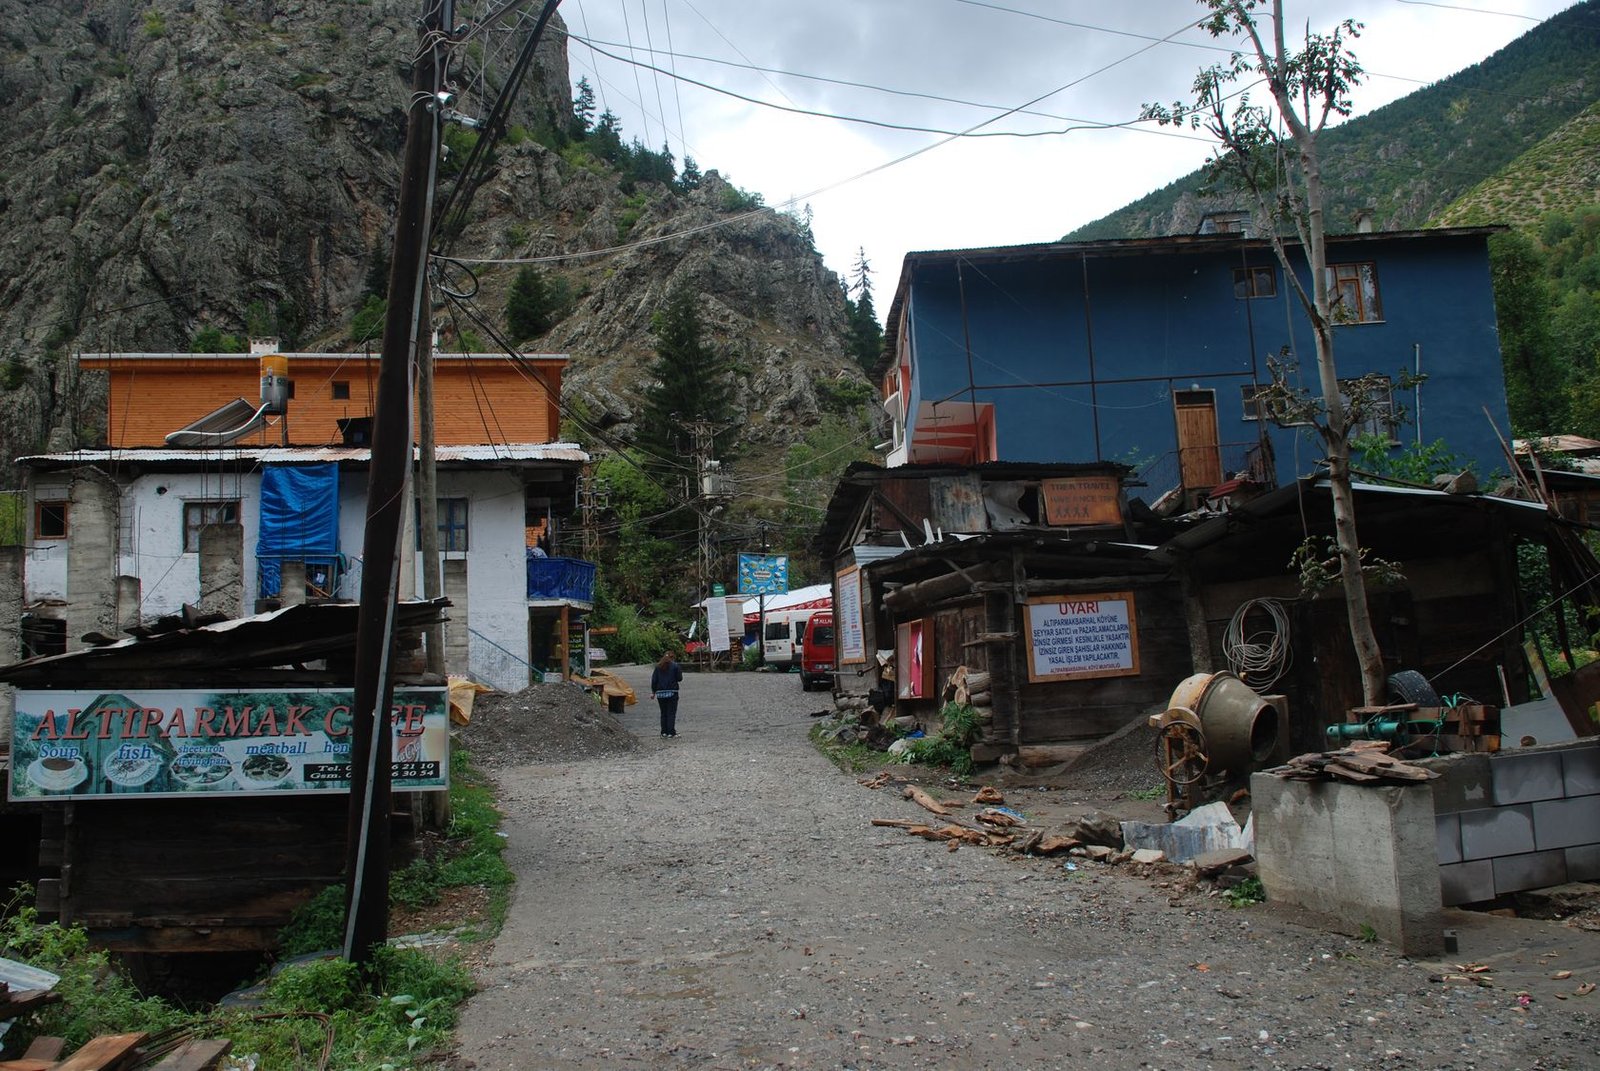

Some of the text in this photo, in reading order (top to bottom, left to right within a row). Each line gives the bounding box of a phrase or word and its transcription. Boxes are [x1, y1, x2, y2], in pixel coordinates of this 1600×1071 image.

[1059, 601, 1100, 615] UYARI
[1033, 628, 1054, 637] SEYYAR
[1055, 627, 1072, 636] SATICI
[31, 703, 428, 741] ALTIPARMAK CE
[39, 742, 79, 759] Soup
[118, 743, 151, 760] fish
[178, 744, 225, 753] sheet iron
[246, 741, 307, 755] meatball
[420, 762, 435, 770] 10
[309, 772, 342, 780] Gsm.
[419, 769, 434, 777] 54
